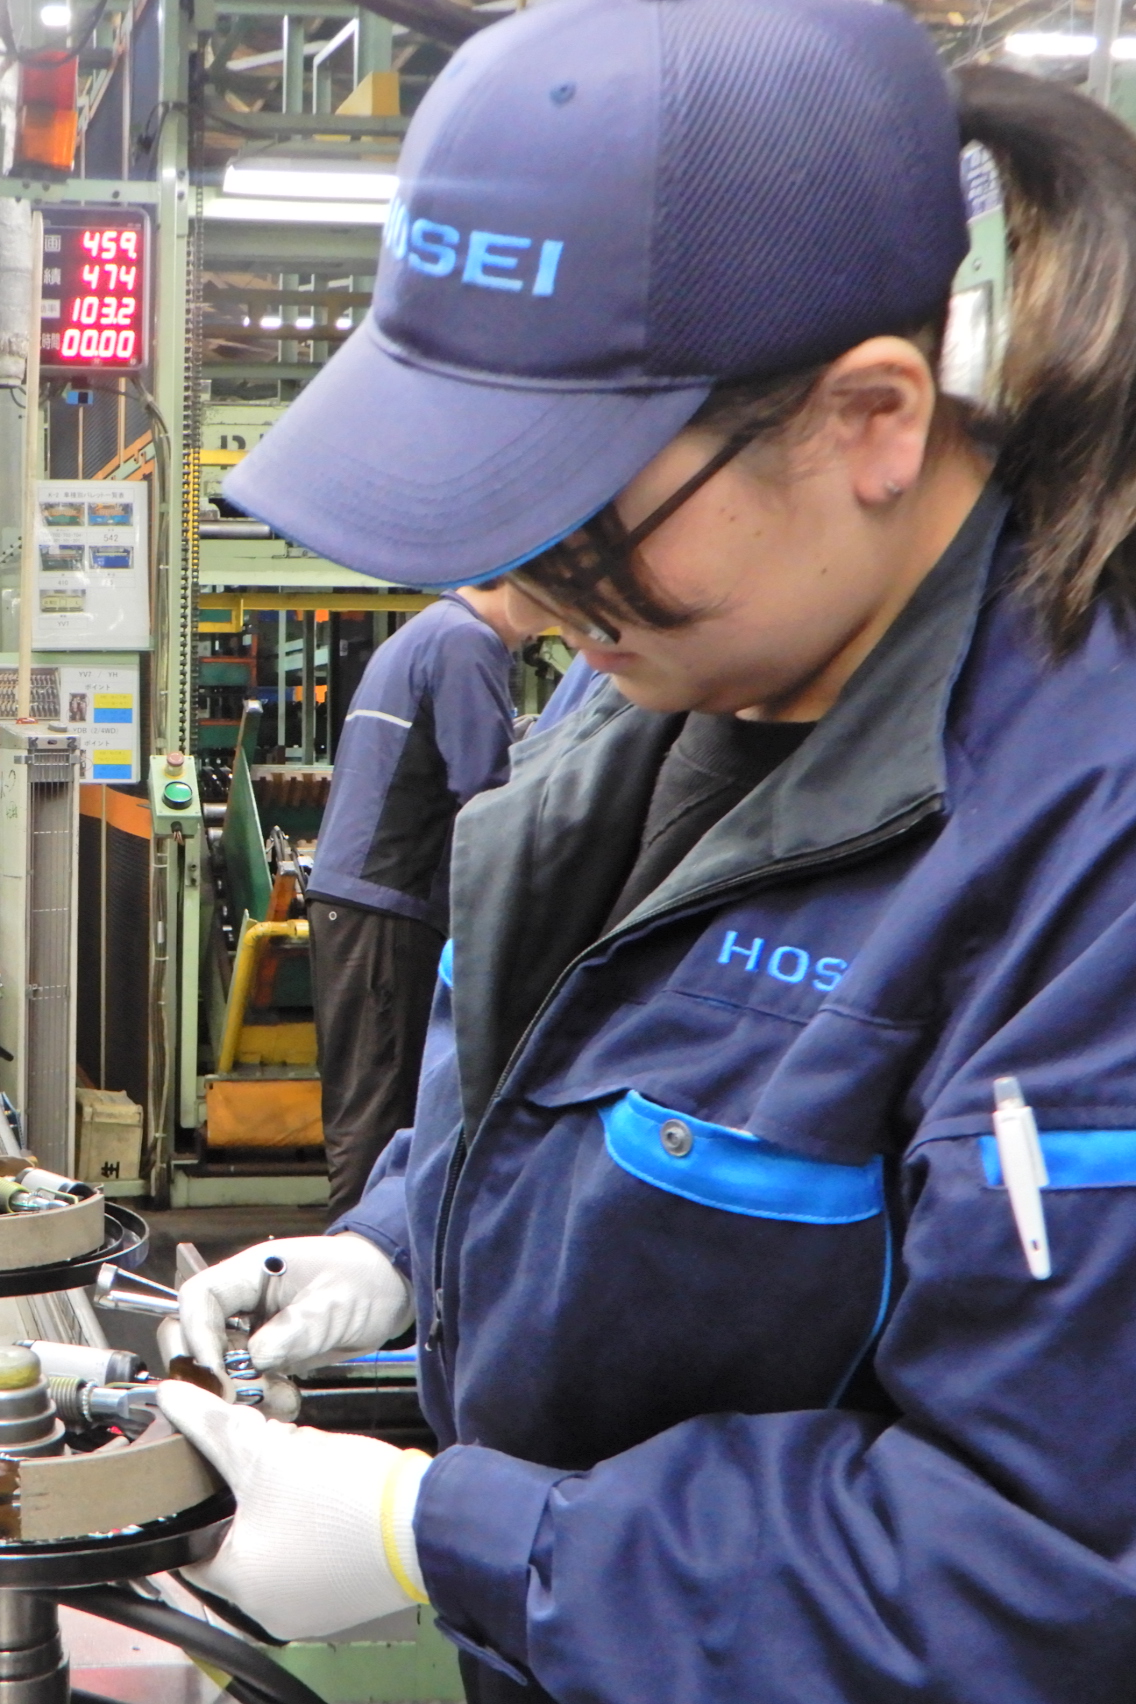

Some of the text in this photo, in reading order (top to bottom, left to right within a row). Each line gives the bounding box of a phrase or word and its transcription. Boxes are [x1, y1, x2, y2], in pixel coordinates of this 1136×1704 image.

[83, 264, 136, 290] 474
[104, 534, 119, 542] 542
[717, 930, 848, 992] HOS
